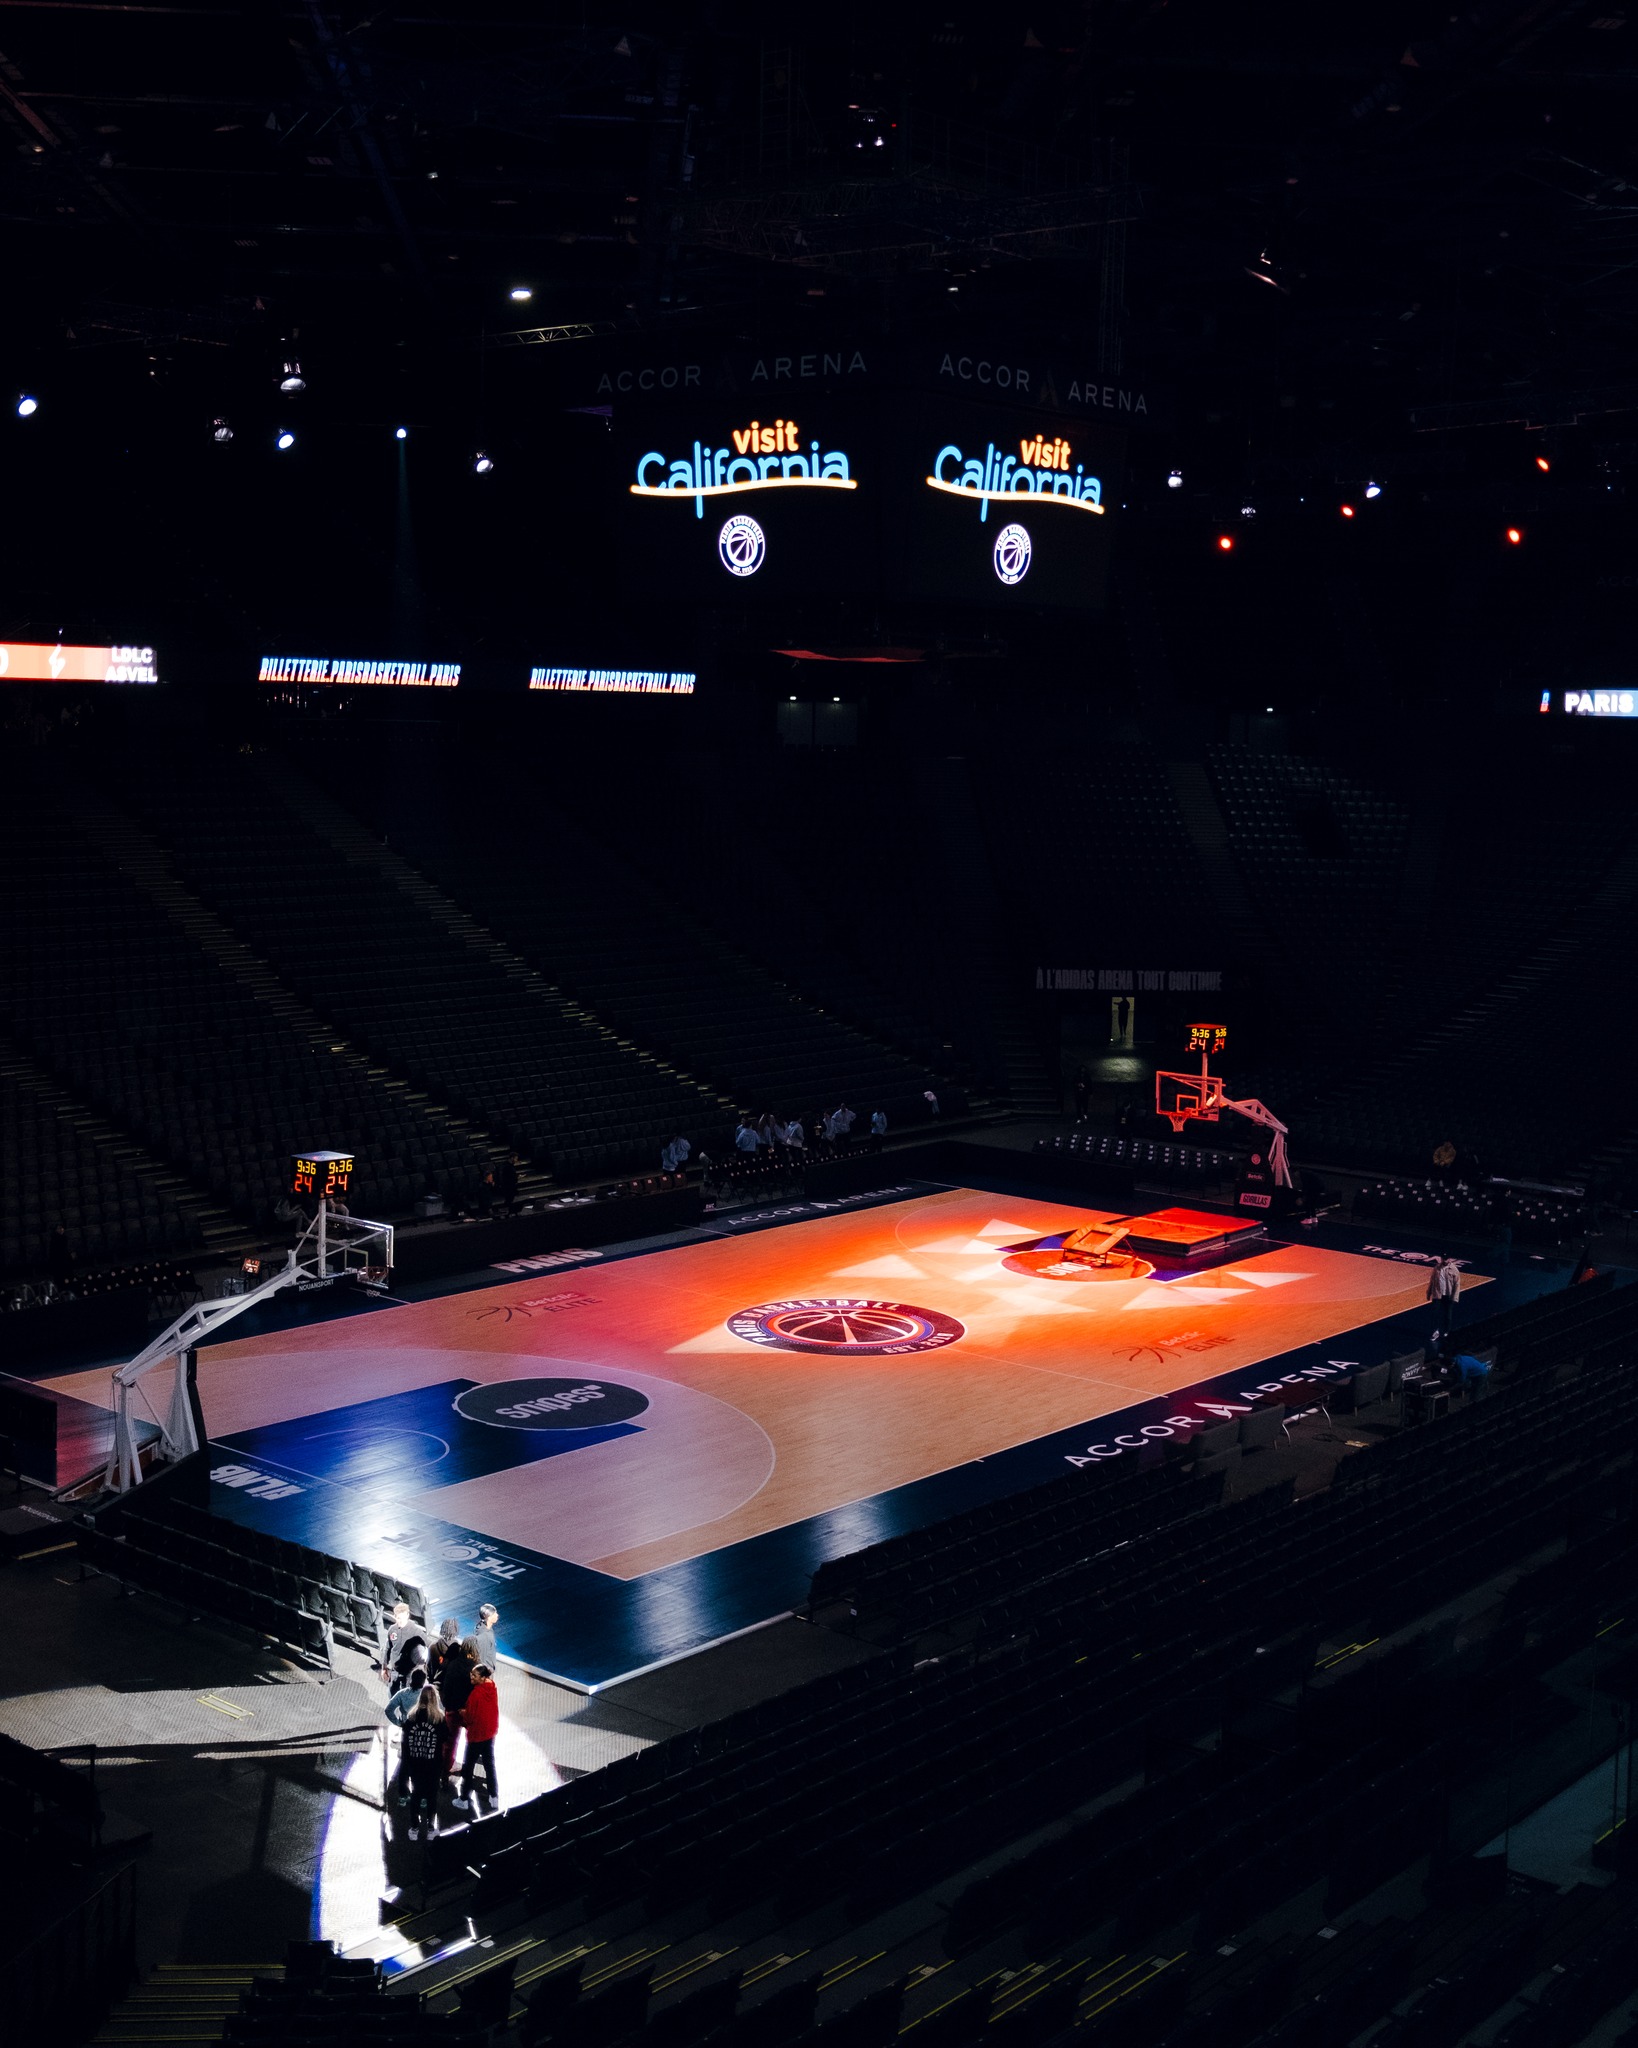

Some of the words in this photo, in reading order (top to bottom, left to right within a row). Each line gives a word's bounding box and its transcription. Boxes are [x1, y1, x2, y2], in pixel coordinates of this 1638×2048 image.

[597, 364, 703, 395] ACCOR
[749, 349, 868, 383] ARENA
[938, 352, 1032, 393] ACCOR
[1066, 379, 1149, 416] ARENA
[732, 419, 800, 454] visit
[1019, 434, 1072, 471] visit
[635, 440, 852, 519] California
[934, 442, 1102, 522] California
[111, 646, 153, 663] LDLC
[105, 666, 158, 683] ASVEL
[1564, 692, 1634, 714] PARIS
[1097, 969, 1134, 991] ARENA
[1136, 970, 1166, 991] TOUT
[1168, 970, 1223, 992] CONTINUE
[1189, 1037, 1206, 1050] 24
[297, 1160, 317, 1175] 9:36
[328, 1159, 353, 1175] 9:36
[294, 1174, 313, 1193] 24
[325, 1174, 348, 1194] 24
[728, 1206, 807, 1226] ACCOR
[836, 1186, 913, 1203] ARENA
[488, 1247, 604, 1274] PARIS
[742, 1299, 902, 1319] BASKETBALL
[732, 1318, 777, 1344] PARIS
[495, 1386, 606, 1419] snipes
[1064, 1415, 1205, 1468] ACCOR
[464, 1538, 499, 1552] BALL
[467, 1556, 526, 1580] THE
